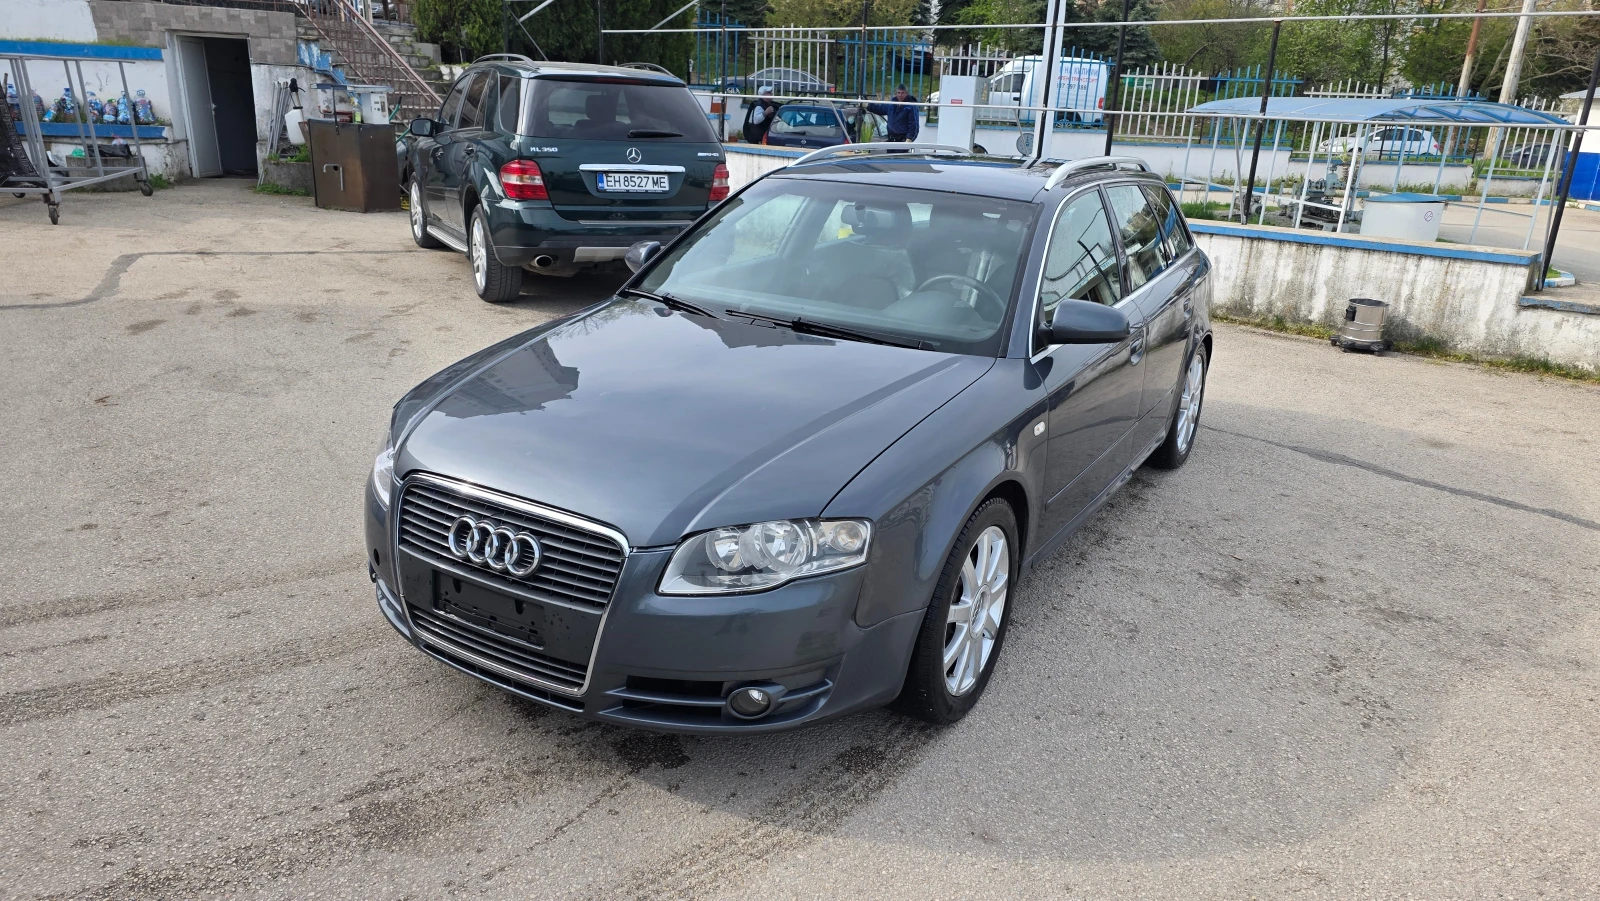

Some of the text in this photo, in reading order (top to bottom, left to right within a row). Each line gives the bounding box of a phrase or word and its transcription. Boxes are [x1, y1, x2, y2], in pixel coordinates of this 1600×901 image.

[606, 175, 667, 189] EH 8527 ME
